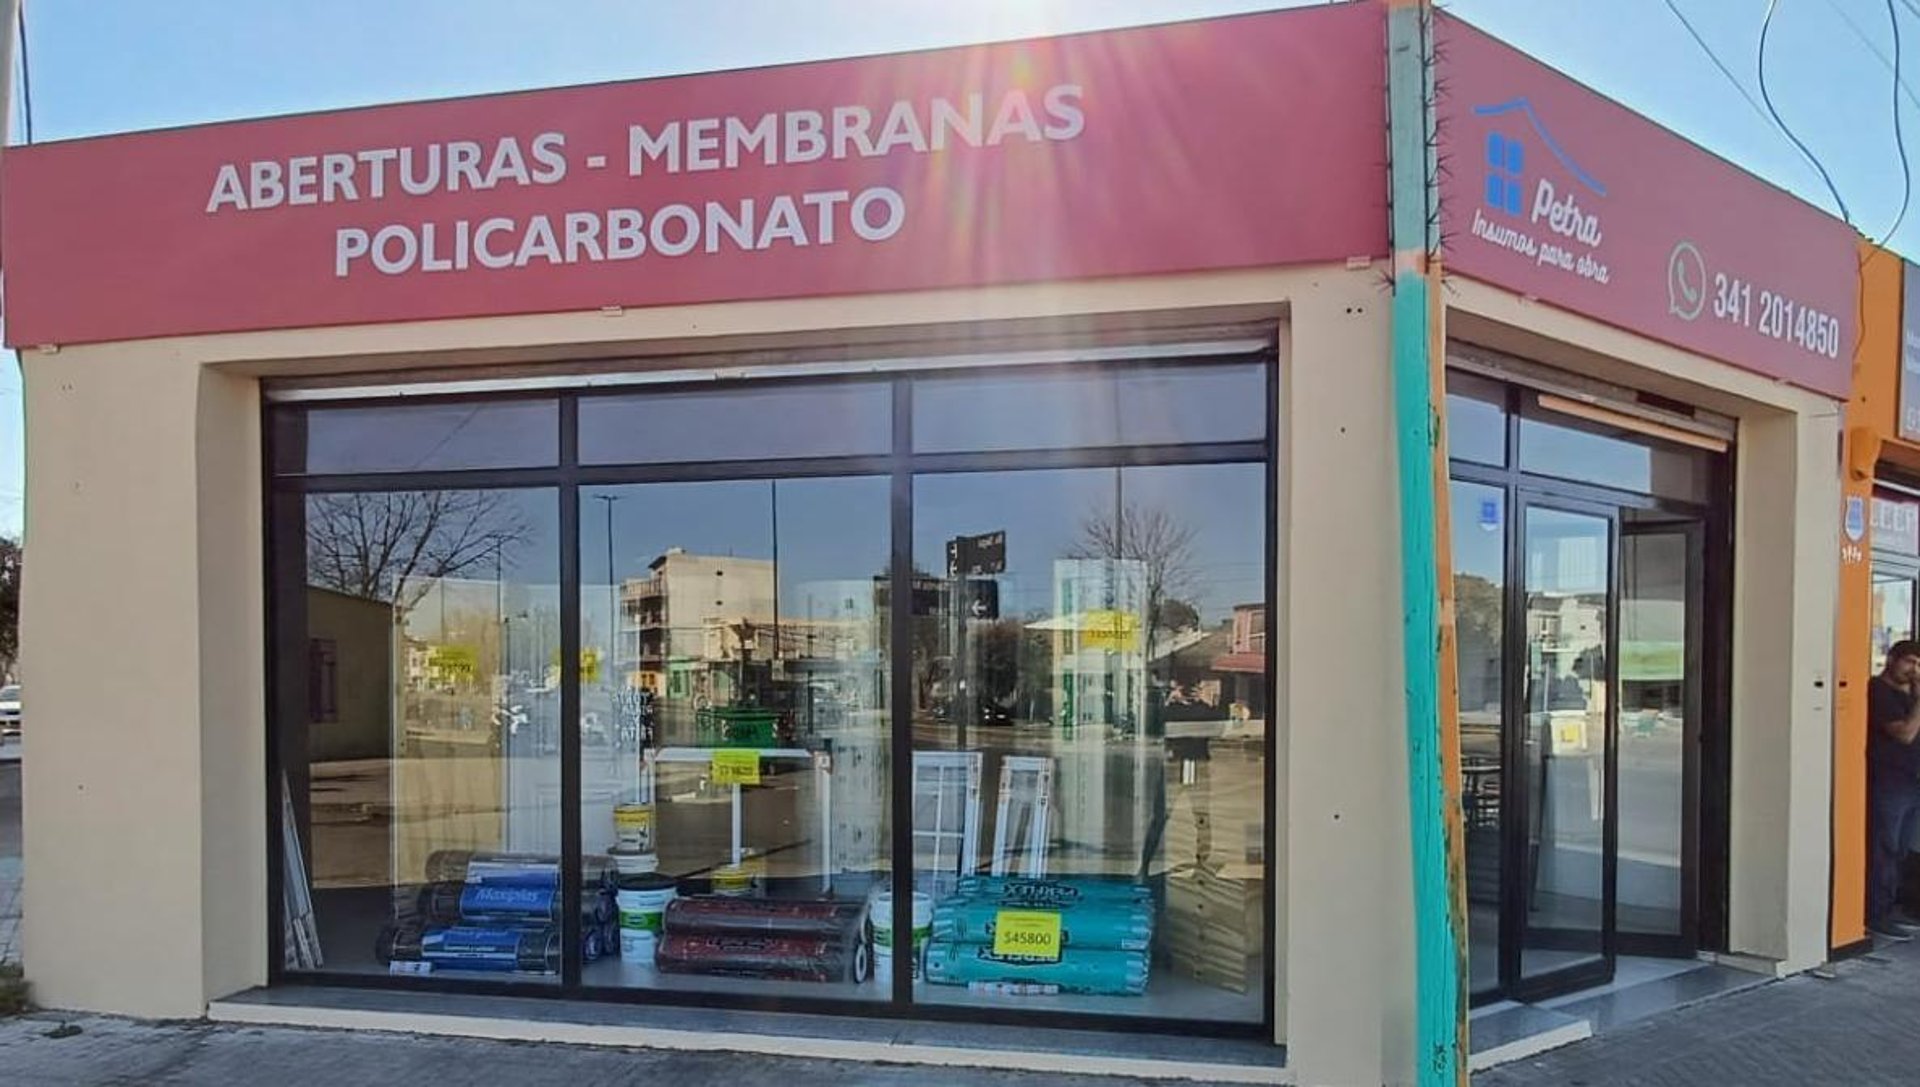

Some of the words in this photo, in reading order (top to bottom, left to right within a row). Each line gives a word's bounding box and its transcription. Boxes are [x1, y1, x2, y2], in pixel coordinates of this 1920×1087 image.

[206, 132, 568, 214] ABERTURAS
[586, 155, 606, 168] -
[627, 84, 1085, 176] MEMBRANAS
[335, 186, 906, 277] POLICARBONATO
[1471, 207, 1538, 257] Insumos
[1537, 242, 1576, 272] para
[1576, 254, 1610, 286] obra
[1531, 177, 1602, 249] Petra
[1713, 272, 1752, 328] 341
[1757, 290, 1840, 359] 2014850
